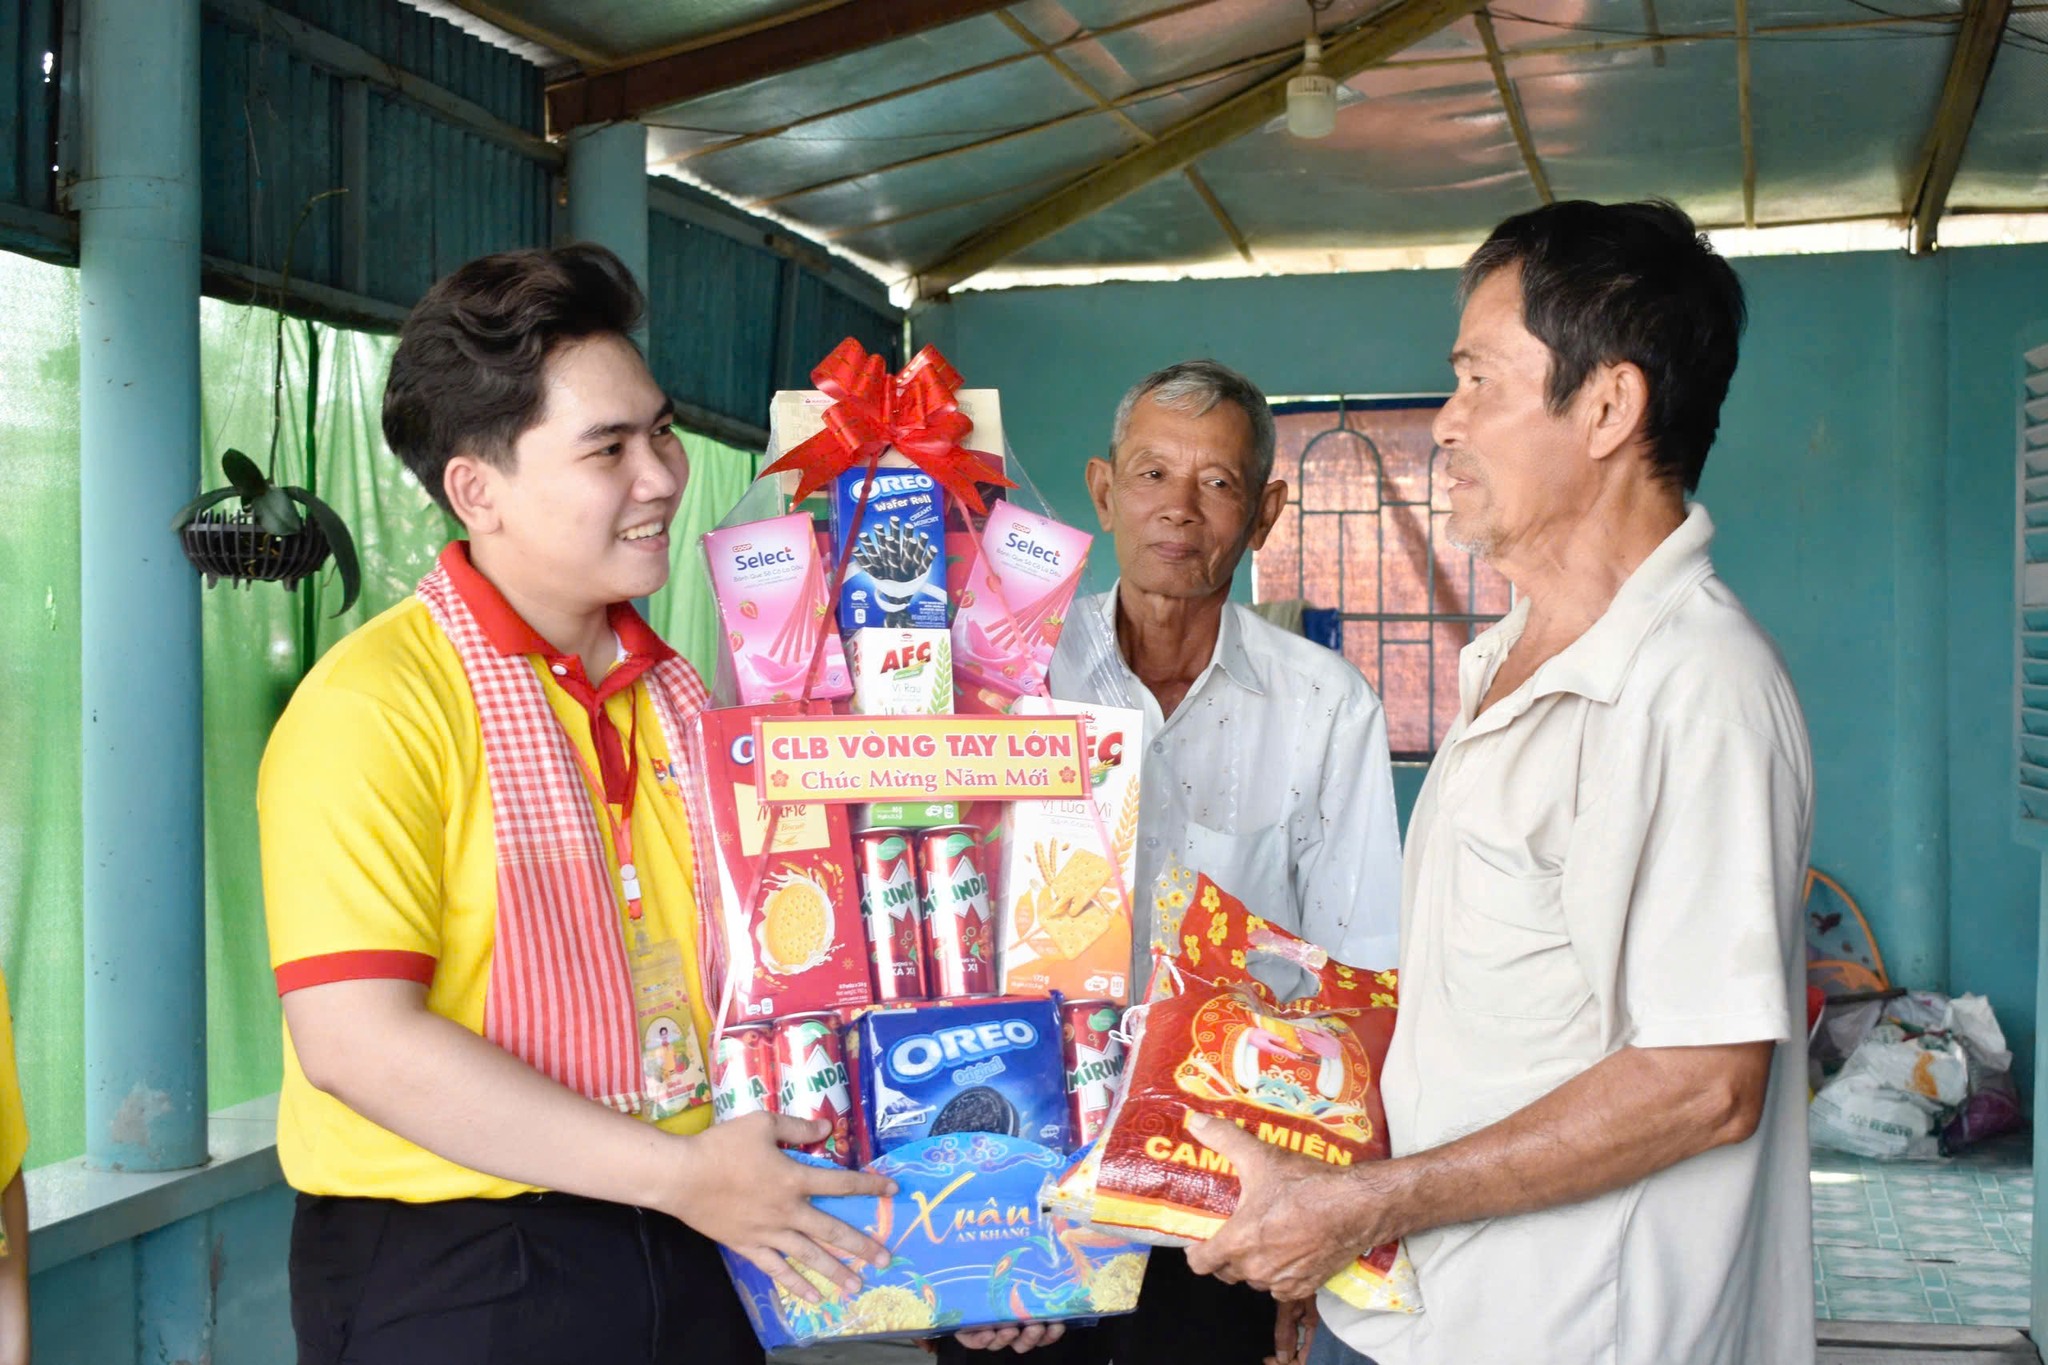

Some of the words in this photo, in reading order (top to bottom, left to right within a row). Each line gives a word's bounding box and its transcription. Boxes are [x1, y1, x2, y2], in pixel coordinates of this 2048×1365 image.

[851, 475, 933, 500] OREO
[875, 498, 908, 512] Wafer
[911, 494, 932, 505] Roll
[735, 547, 795, 571] Select
[1005, 533, 1060, 566] Select
[881, 641, 931, 674] AFC
[772, 737, 829, 760] CLB
[837, 730, 935, 759] VÒNG
[946, 735, 997, 757] TAY
[1008, 730, 1071, 757] LỚN
[801, 770, 861, 790] Chúc
[870, 769, 937, 792] Mừng
[945, 768, 997, 786] Năm
[1005, 768, 1049, 786] Mới
[889, 1020, 1036, 1078] OREO
[954, 1057, 1005, 1085] Original
[891, 1171, 1035, 1253] Xuân
[955, 1233, 977, 1242] AN
[979, 1227, 1030, 1242] KHANG
